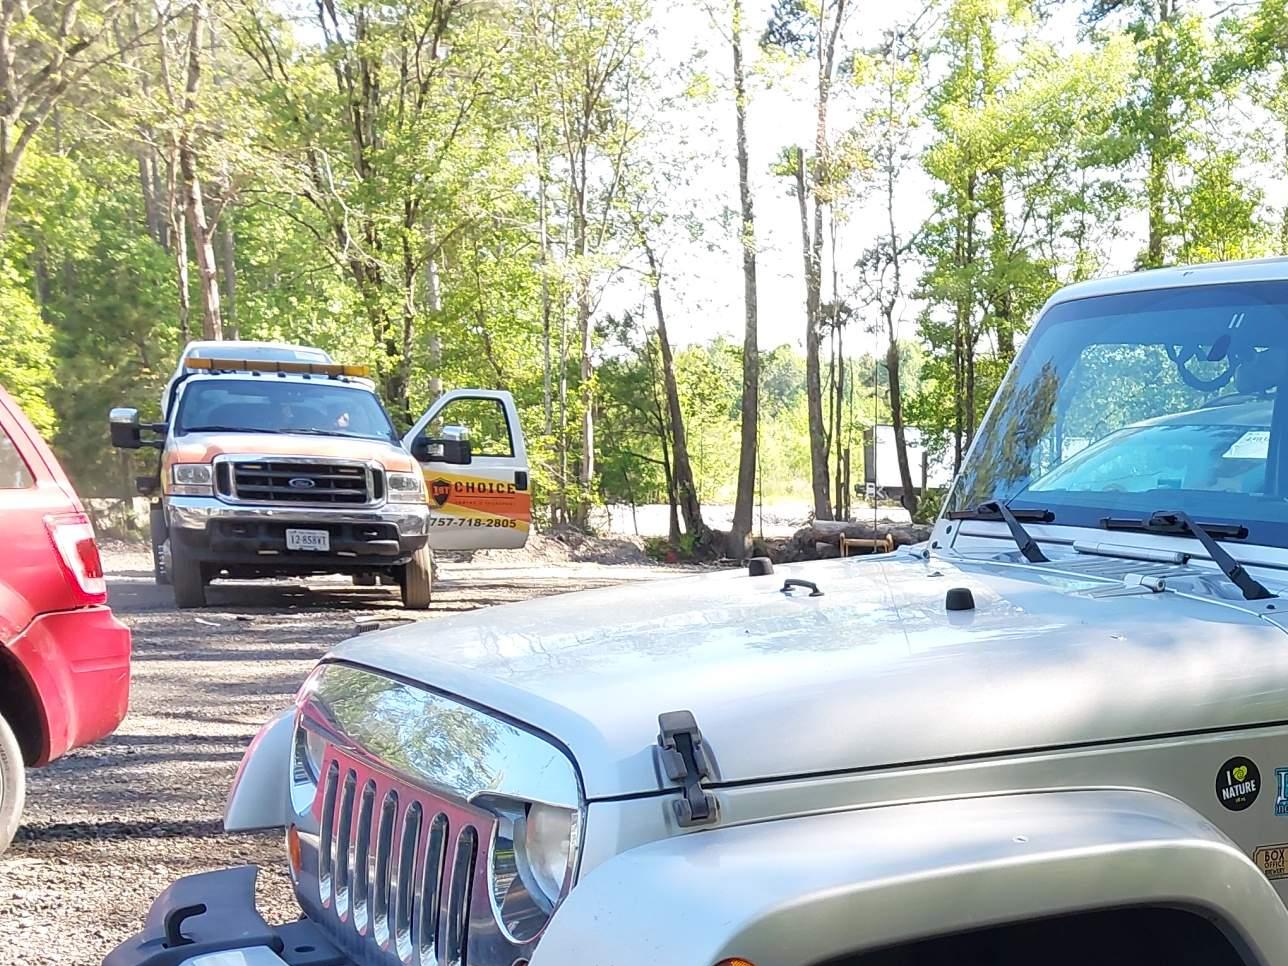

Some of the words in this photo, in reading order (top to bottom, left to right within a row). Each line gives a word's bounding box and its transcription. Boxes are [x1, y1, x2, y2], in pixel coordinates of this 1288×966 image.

[454, 481, 516, 495] CHOICE
[430, 517, 517, 529] 757-718-2805
[1226, 770, 1232, 785] I
[1222, 779, 1257, 801] NATURE
[1264, 849, 1285, 861] BOX
[1264, 860, 1285, 869] OFFICE
